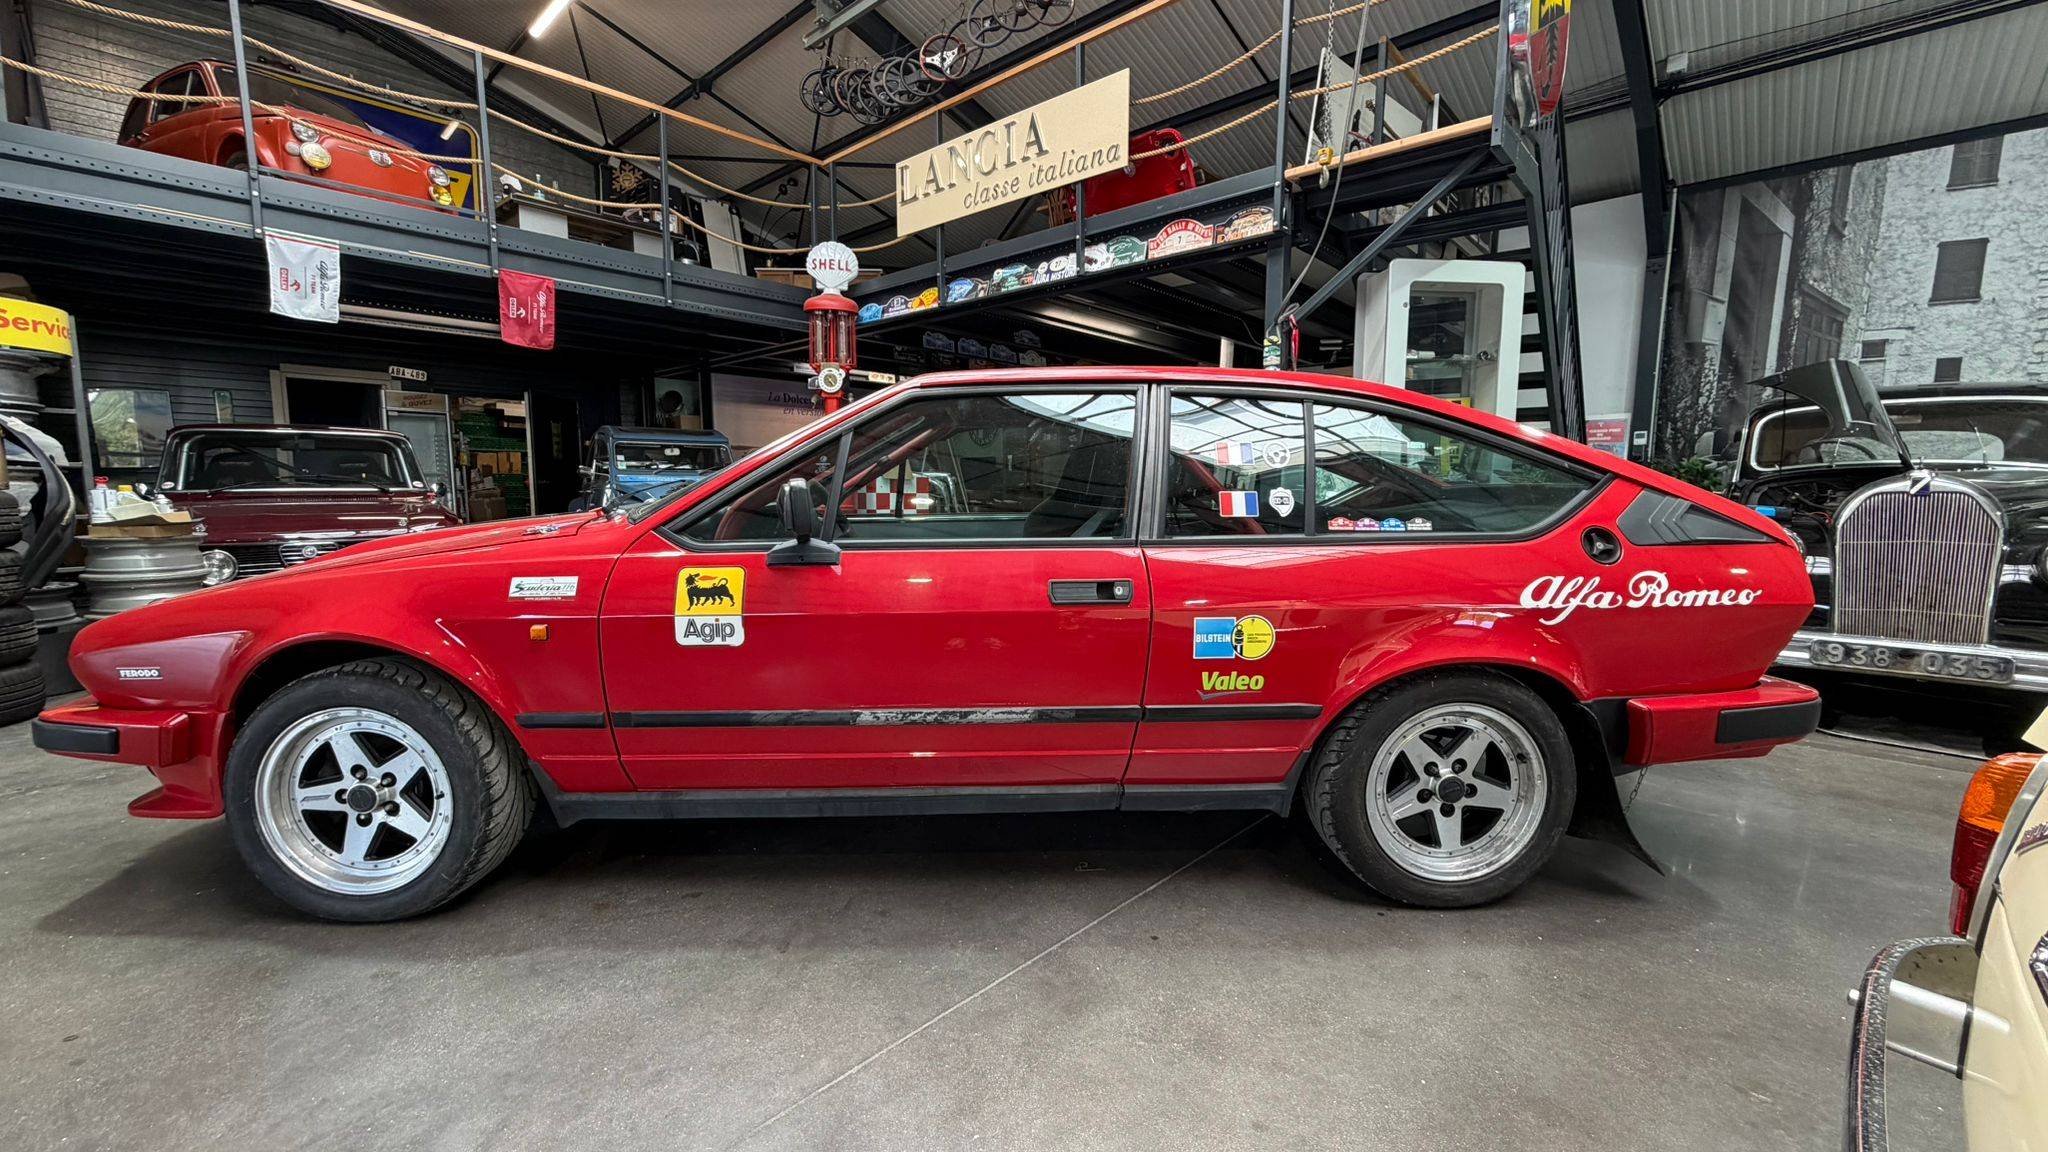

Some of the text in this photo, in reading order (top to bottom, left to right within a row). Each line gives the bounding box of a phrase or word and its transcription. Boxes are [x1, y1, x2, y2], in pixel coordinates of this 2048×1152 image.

[898, 112, 1050, 207] LANCIA
[963, 142, 1122, 209] classe italiana
[811, 258, 852, 272] SHELL
[1051, 267, 1077, 281] HISTOR
[1519, 570, 1763, 626] Alfa Romeo
[683, 618, 736, 643] Agip
[1195, 633, 1231, 643] BILSTEIN
[1826, 643, 1995, 680] 938 035
[119, 669, 159, 678] FERODO
[1201, 671, 1265, 691] Valeo
